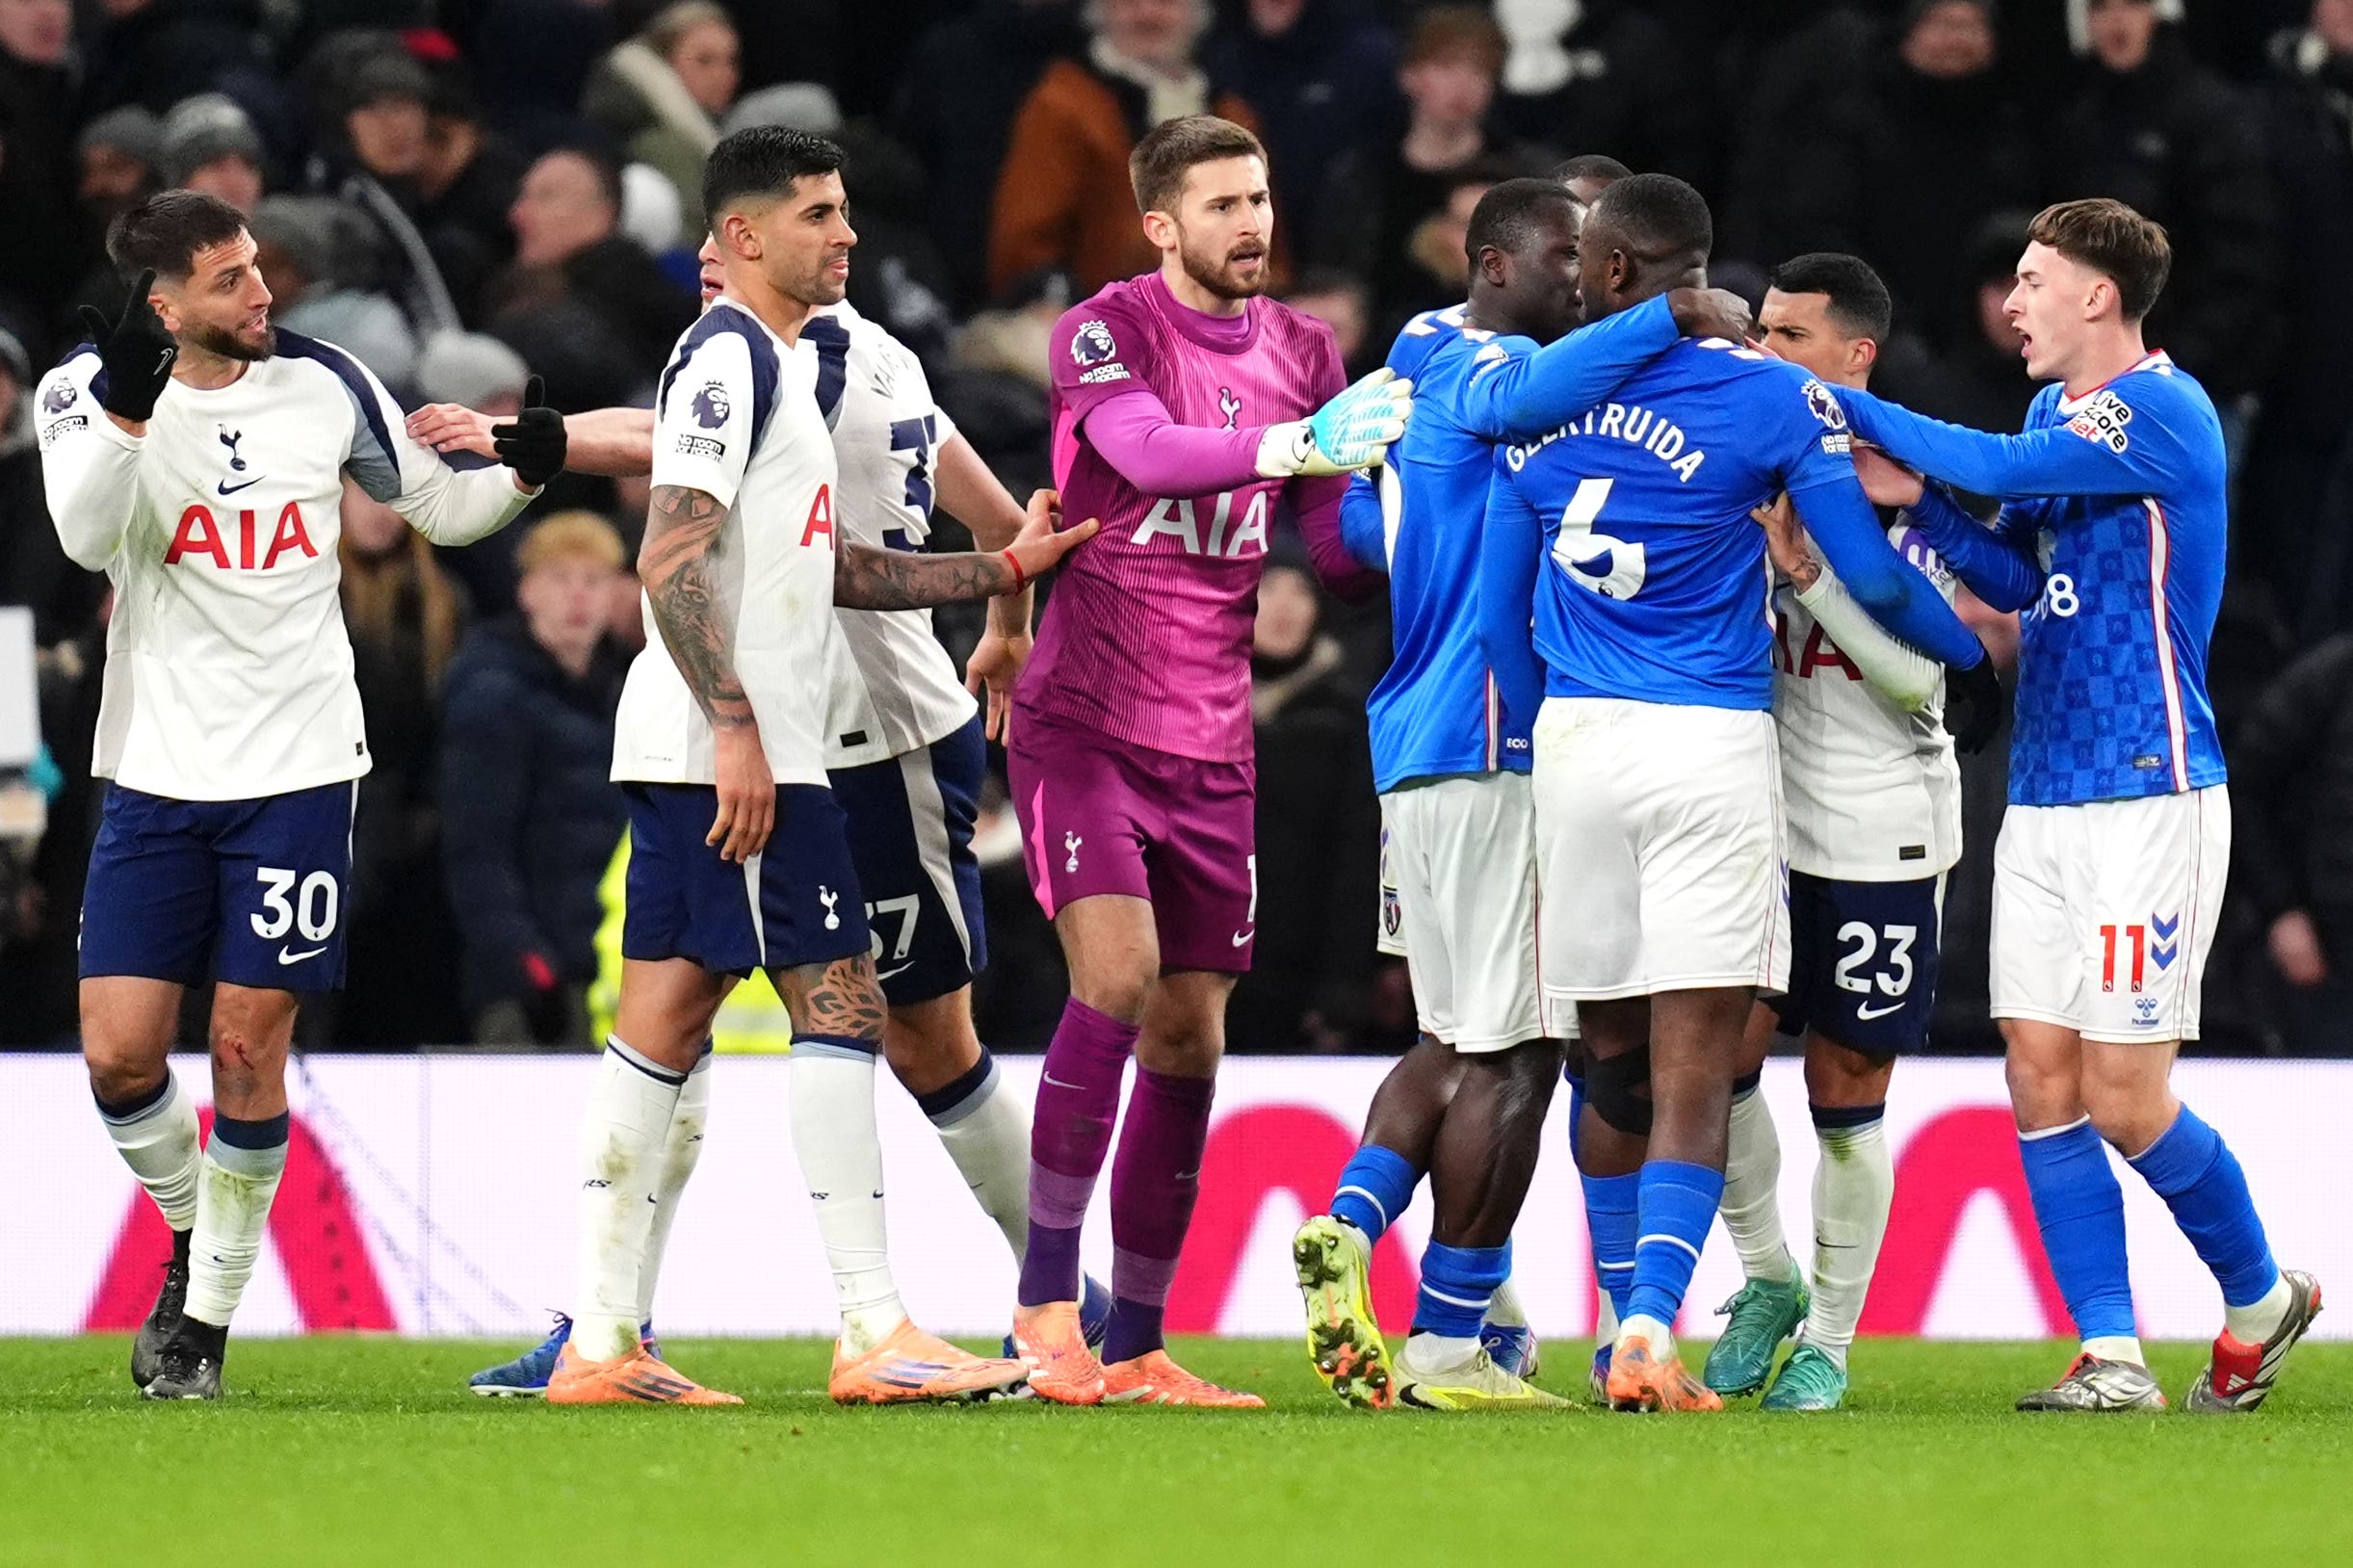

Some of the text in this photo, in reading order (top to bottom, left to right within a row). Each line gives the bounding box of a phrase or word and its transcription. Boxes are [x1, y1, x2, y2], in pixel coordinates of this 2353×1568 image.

[1506, 403, 1705, 483] GTRUIDA
[164, 501, 319, 570] AIA
[1131, 490, 1268, 557] AIA
[1552, 478, 1646, 601] 6
[250, 867, 338, 941] 30
[1835, 921, 1918, 996] 23
[2100, 925, 2145, 992] 11
